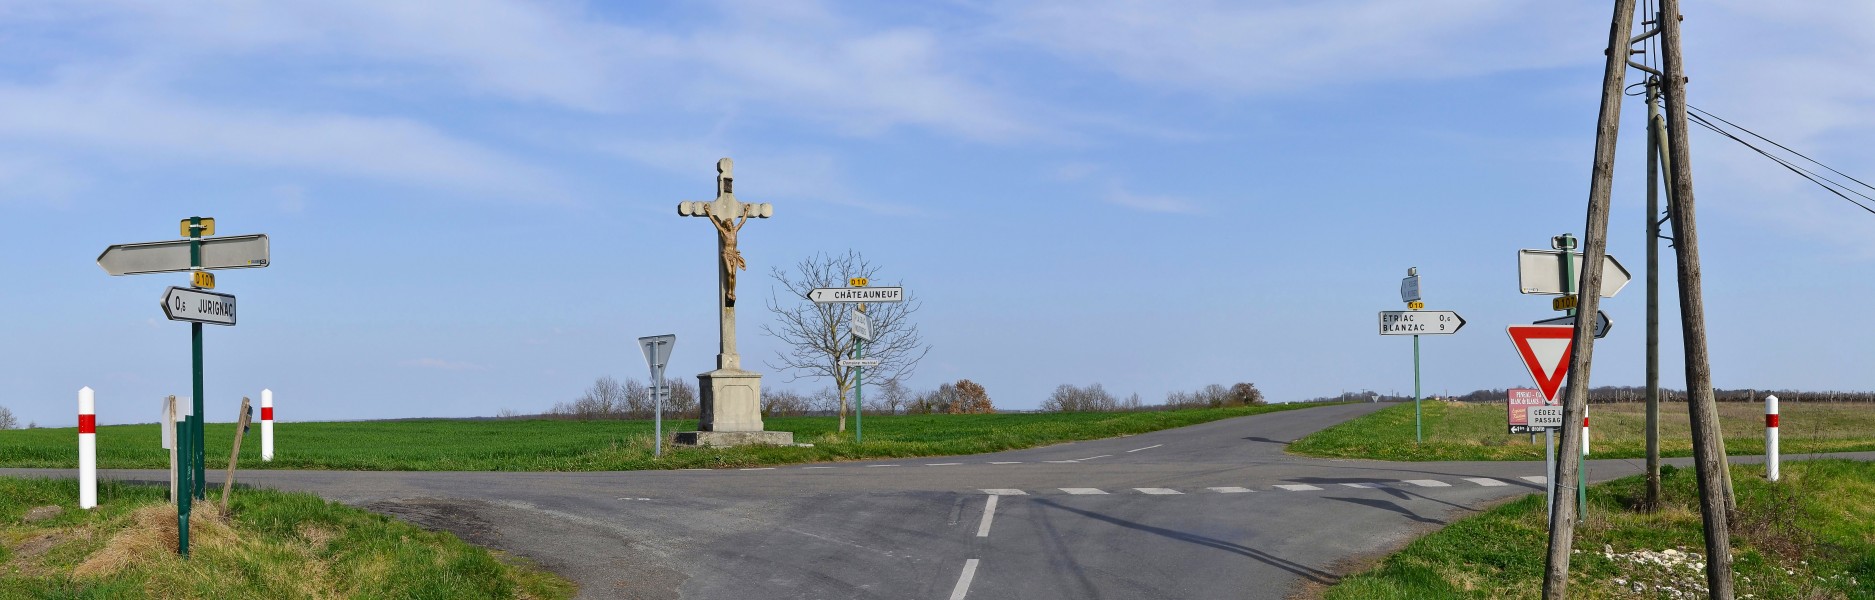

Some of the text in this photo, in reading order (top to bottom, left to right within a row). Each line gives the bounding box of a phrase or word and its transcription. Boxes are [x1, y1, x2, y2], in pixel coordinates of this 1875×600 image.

[834, 290, 898, 298] CHÂTEAUNEUF
[198, 299, 233, 317] JURIGNAC
[1383, 314, 1414, 322] ÉTRIAC
[1533, 408, 1556, 416] CÉDEZ
